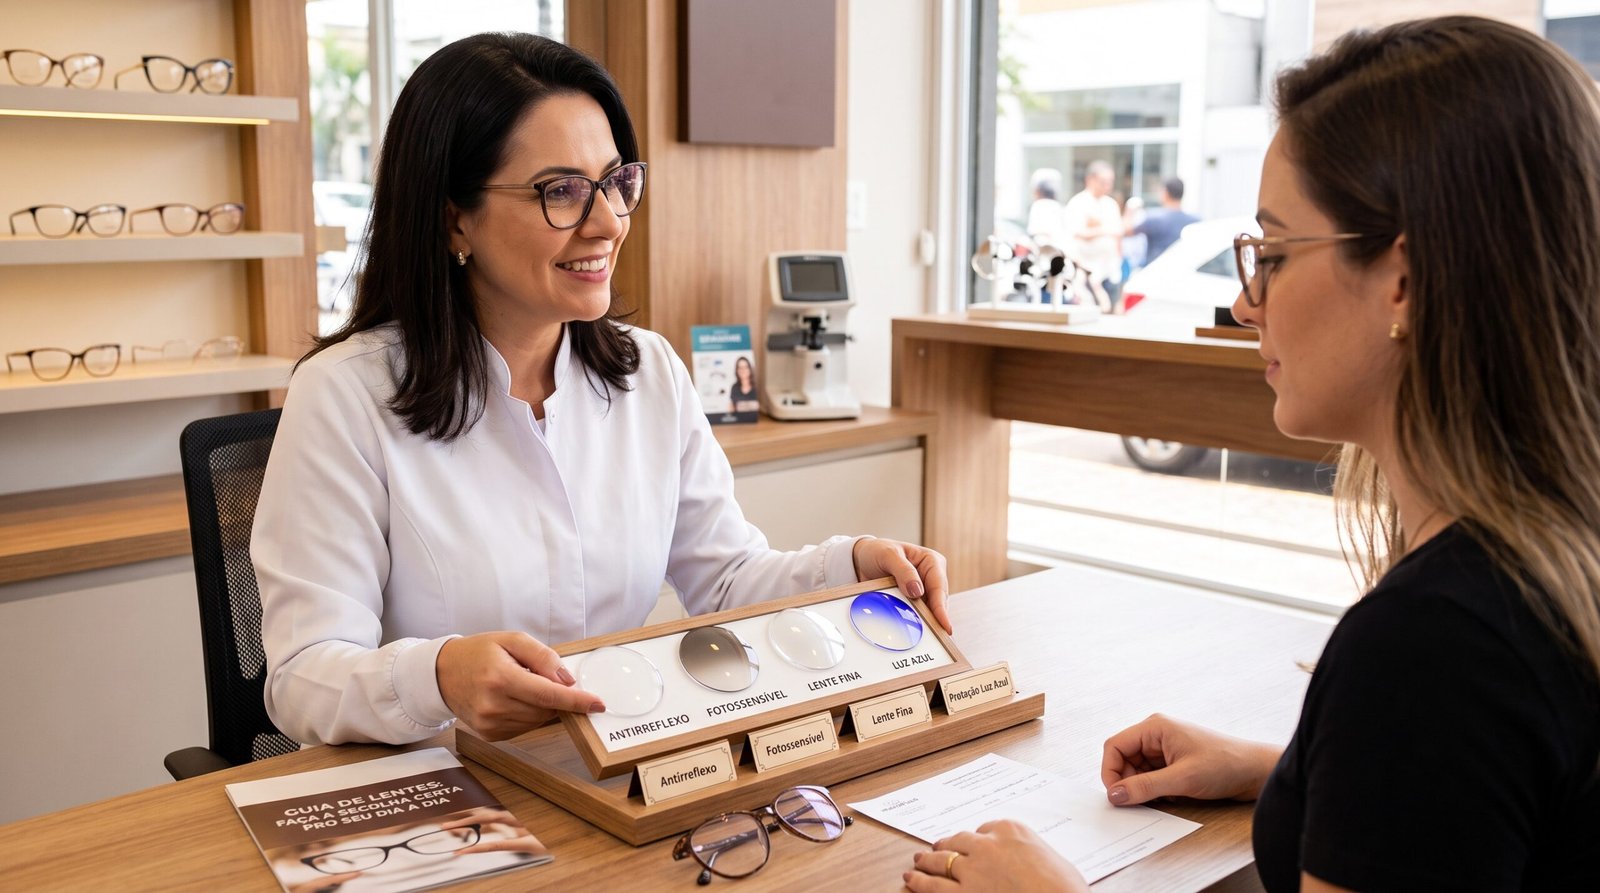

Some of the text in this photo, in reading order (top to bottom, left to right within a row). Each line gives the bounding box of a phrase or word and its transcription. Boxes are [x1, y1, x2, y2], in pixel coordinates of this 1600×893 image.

[892, 653, 934, 670] LUZ AZUL
[807, 671, 862, 691] LENTE FINA
[948, 676, 1009, 703] Protação Luz Azul
[706, 689, 788, 717] FOTOSSENSÍVEL
[872, 703, 914, 725] Lente Fina
[608, 713, 690, 742] ANTIRREFLEXO
[766, 731, 825, 756] Fotossensível
[660, 763, 718, 788] Antirreflexo
[275, 785, 463, 827] FAÇA A SECOLHA CERTA
[284, 780, 444, 817] GUIA DE LENTES:
[302, 820, 337, 831] PRO
[340, 813, 372, 824] SEU
[375, 807, 405, 817] DIA
[421, 797, 451, 808] DIA
